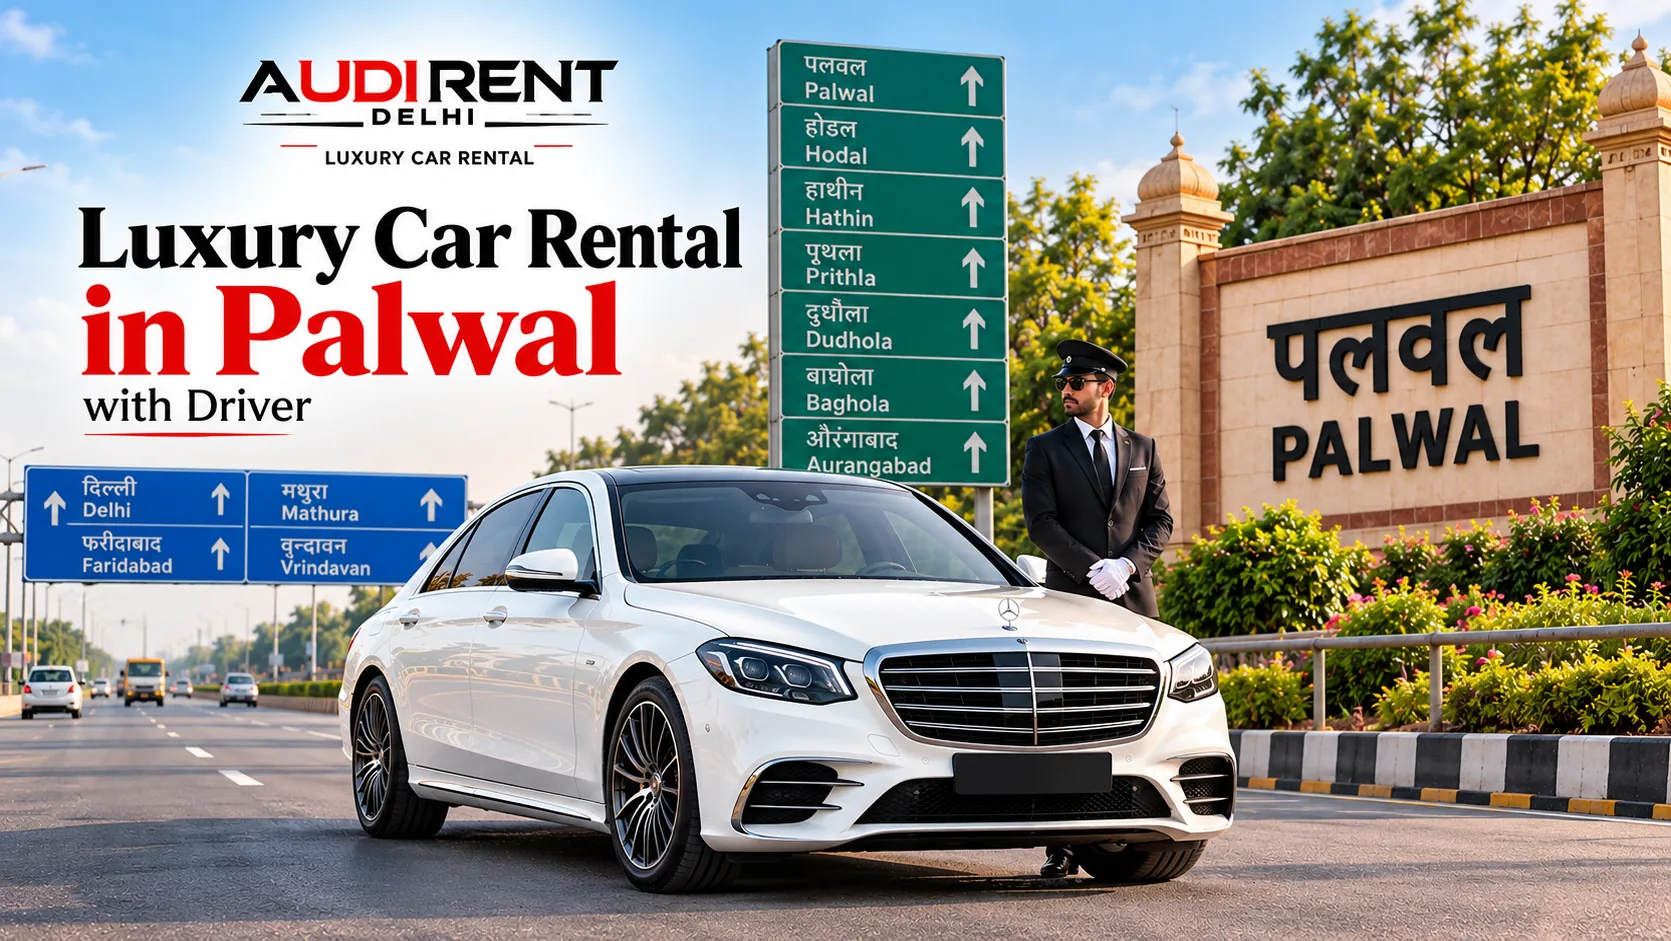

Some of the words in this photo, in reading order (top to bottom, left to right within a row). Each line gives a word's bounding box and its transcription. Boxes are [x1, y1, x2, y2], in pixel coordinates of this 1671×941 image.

[804, 55, 867, 76] पलवल
[805, 82, 874, 103] Palwal
[804, 112, 858, 138] होडल
[806, 145, 867, 165] Hodal
[804, 176, 864, 201] हाथीन
[806, 208, 873, 228] Hathin
[806, 267, 876, 287] Prithla
[805, 297, 869, 327] दुधौला
[806, 330, 893, 350] Dudhola
[1266, 284, 1532, 402] पलवल
[806, 362, 874, 386] बाघोला
[806, 394, 890, 416] Baghola
[806, 423, 899, 450] औरंगाबाद
[1272, 400, 1540, 482] PALWAL
[806, 456, 932, 477] Aurangabad
[81, 475, 138, 497] दिल्ली
[281, 483, 329, 505] मथुरा
[83, 502, 131, 518] Delhi
[282, 505, 359, 522] Mathura
[81, 530, 163, 553] फरीदाबाद
[83, 557, 173, 574] Faridabad
[280, 560, 371, 576] Vrindavan
